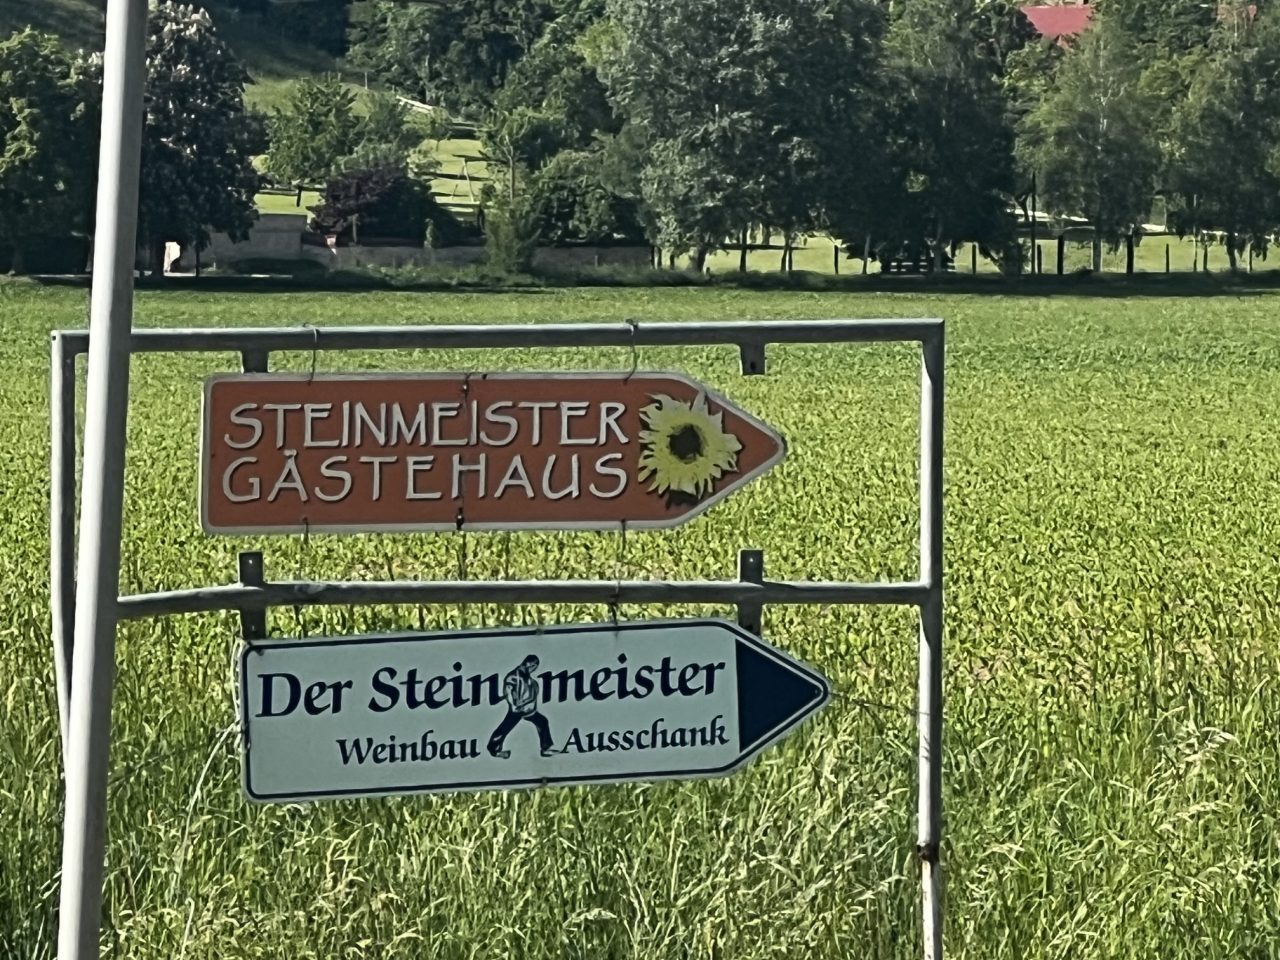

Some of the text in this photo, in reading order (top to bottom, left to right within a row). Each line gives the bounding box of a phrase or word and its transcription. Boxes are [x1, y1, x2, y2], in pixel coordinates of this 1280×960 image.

[224, 400, 630, 450] STEINMEISTER
[222, 451, 629, 503] GÄSTEHAUS
[255, 669, 353, 719] Der
[336, 715, 729, 766] Weinbau Ausschank
